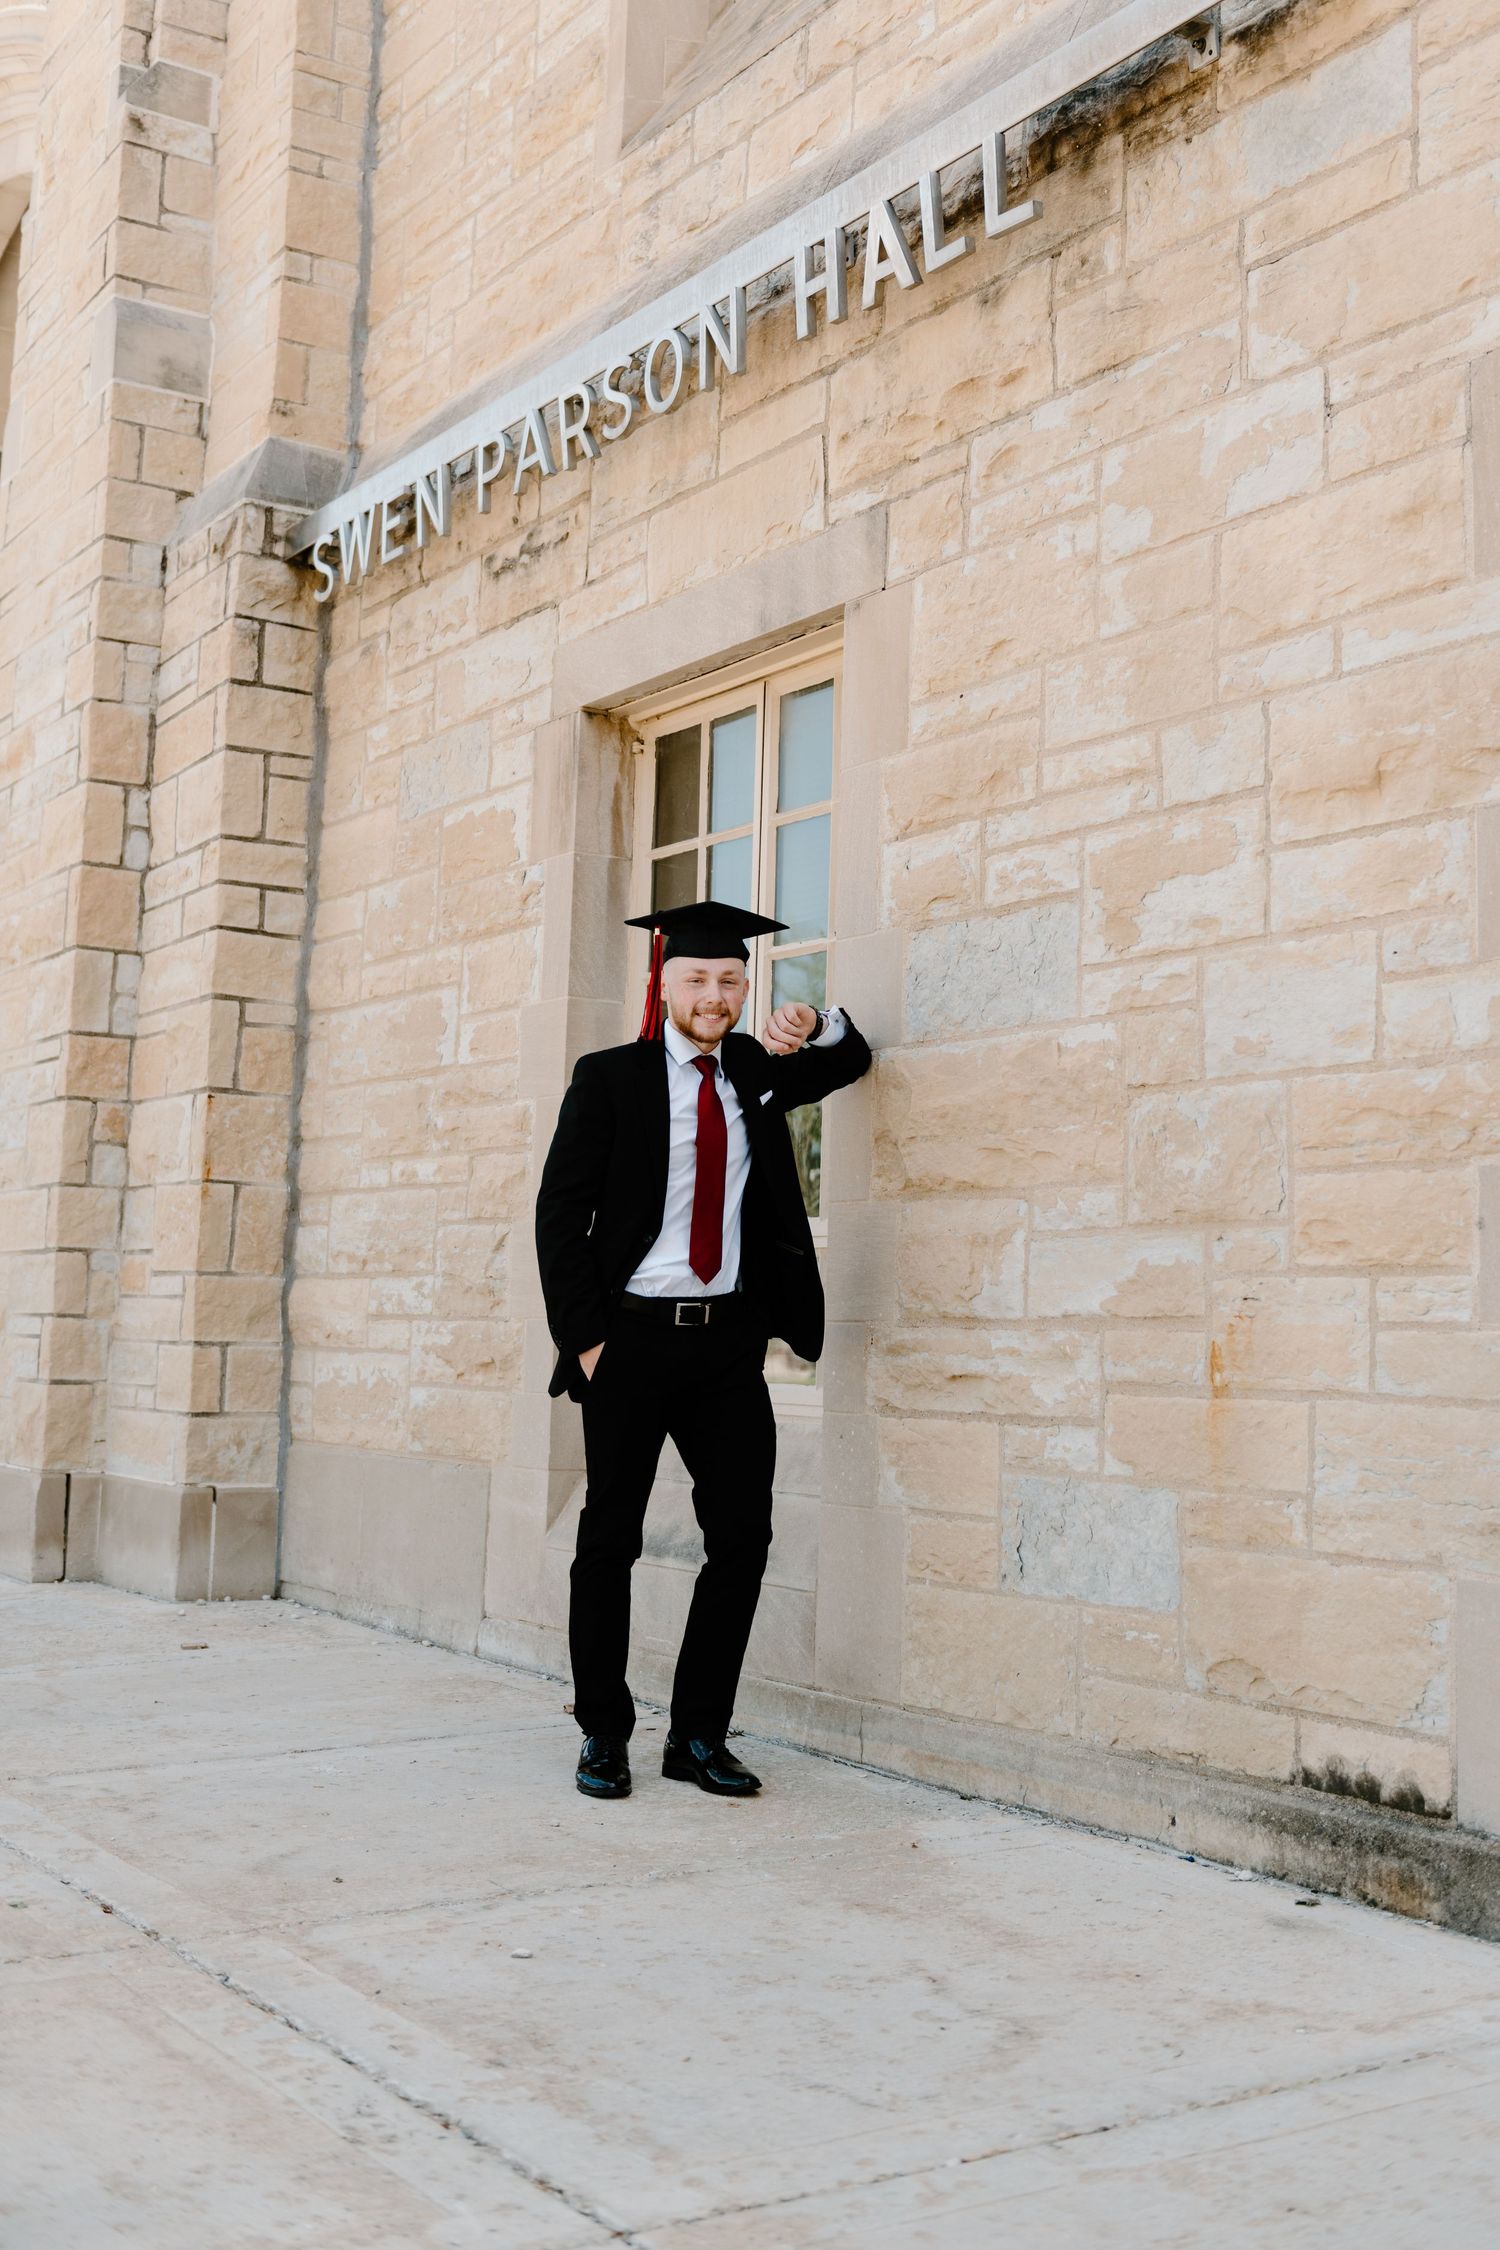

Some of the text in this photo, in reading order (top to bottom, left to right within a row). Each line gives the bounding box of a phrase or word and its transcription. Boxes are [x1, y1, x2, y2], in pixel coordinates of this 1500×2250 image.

[311, 131, 1043, 601] SWEN PARSON HALL
